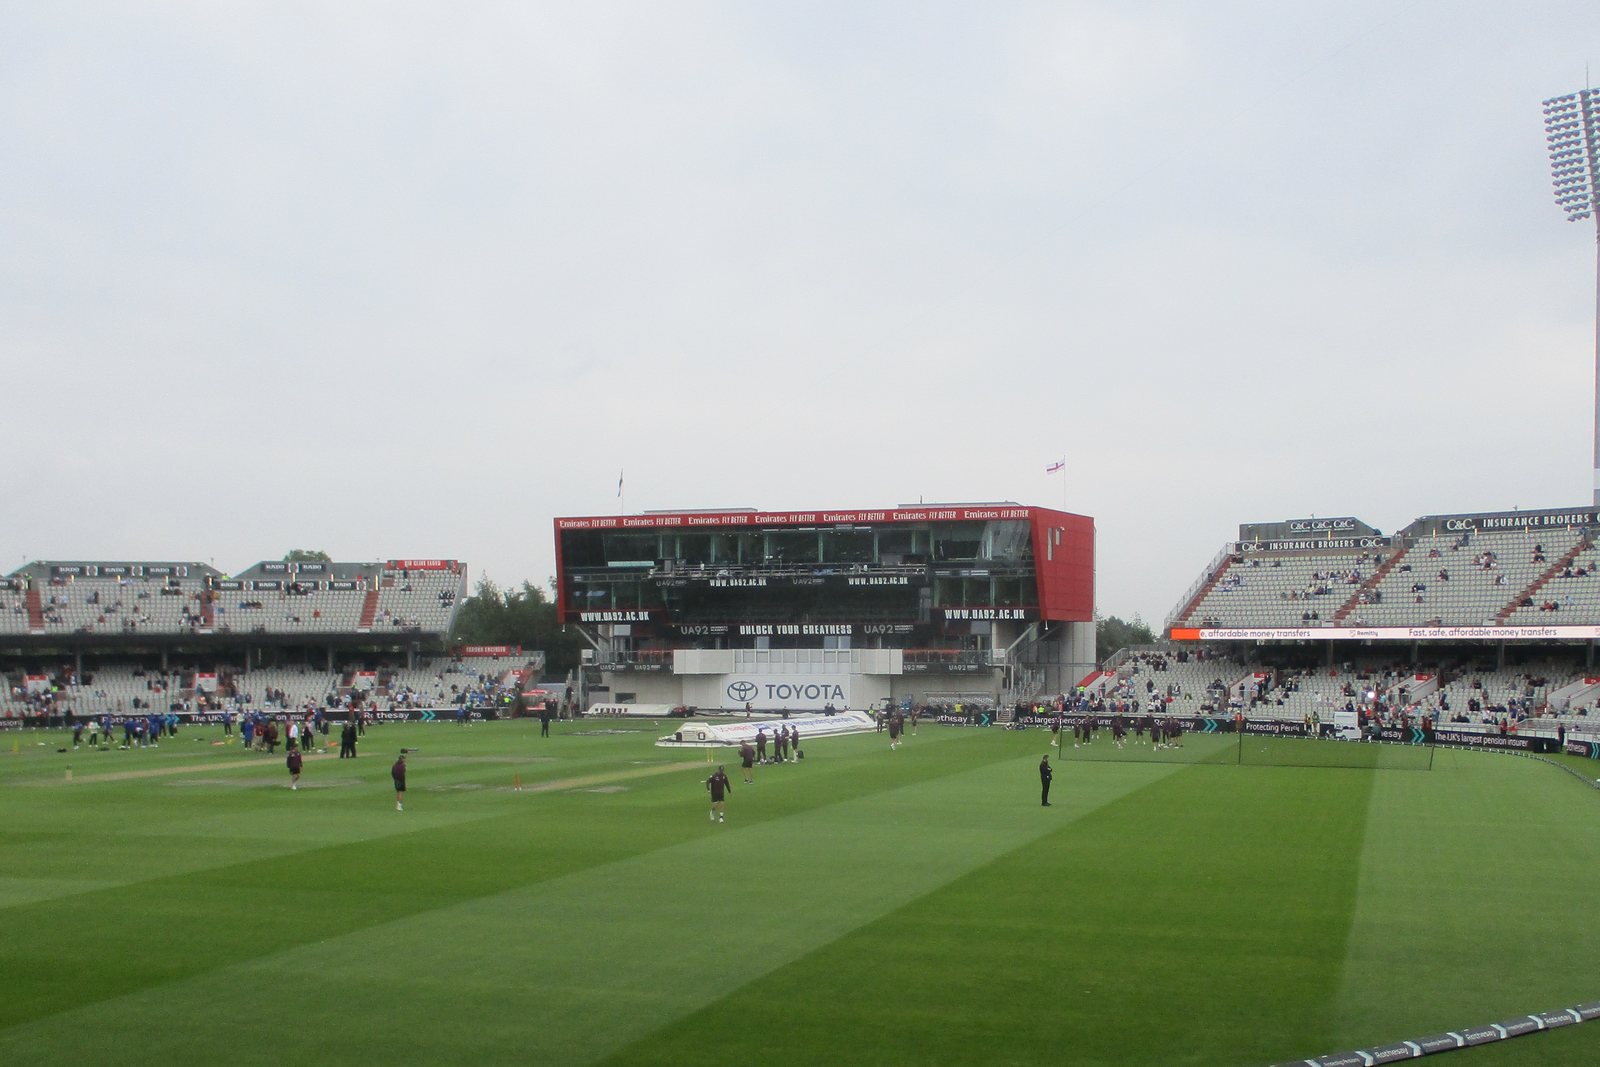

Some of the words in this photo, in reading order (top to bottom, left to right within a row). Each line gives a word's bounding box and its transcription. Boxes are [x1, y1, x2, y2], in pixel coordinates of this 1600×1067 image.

[755, 515, 787, 523] Emirates
[893, 512, 926, 520] Emirates
[964, 510, 998, 518] Emirates
[1001, 510, 1011, 518] FLY
[1010, 510, 1029, 518] BETTER
[688, 516, 720, 524] Emirates
[1483, 516, 1539, 528] INSURANCE
[1544, 514, 1590, 525] BROKERS
[1270, 542, 1314, 550] INSURANCE
[1318, 540, 1354, 549] BROKERS
[580, 611, 650, 622] WWW.UA92.AC.UK
[944, 609, 1024, 620] WWW.UA92.AC.UK
[680, 626, 708, 634] UA92
[740, 625, 773, 634] UNLOCK
[776, 625, 799, 634] YOUR
[802, 624, 852, 634] GREATNESS
[864, 624, 894, 634] UA92
[1208, 630, 1248, 638] affordable
[1408, 628, 1427, 637] Fast,
[1428, 628, 1447, 637] safe,
[1449, 628, 1491, 636] affordable
[1520, 628, 1557, 636] transfers
[765, 685, 844, 700] TOYOTA
[1246, 722, 1279, 733] Protecting
[1462, 734, 1482, 744] largest
[1484, 737, 1506, 746] pension
[1508, 738, 1528, 746] insurer
[1466, 1030, 1496, 1040] Rothesay
[1375, 1048, 1408, 1058] Rothesay
